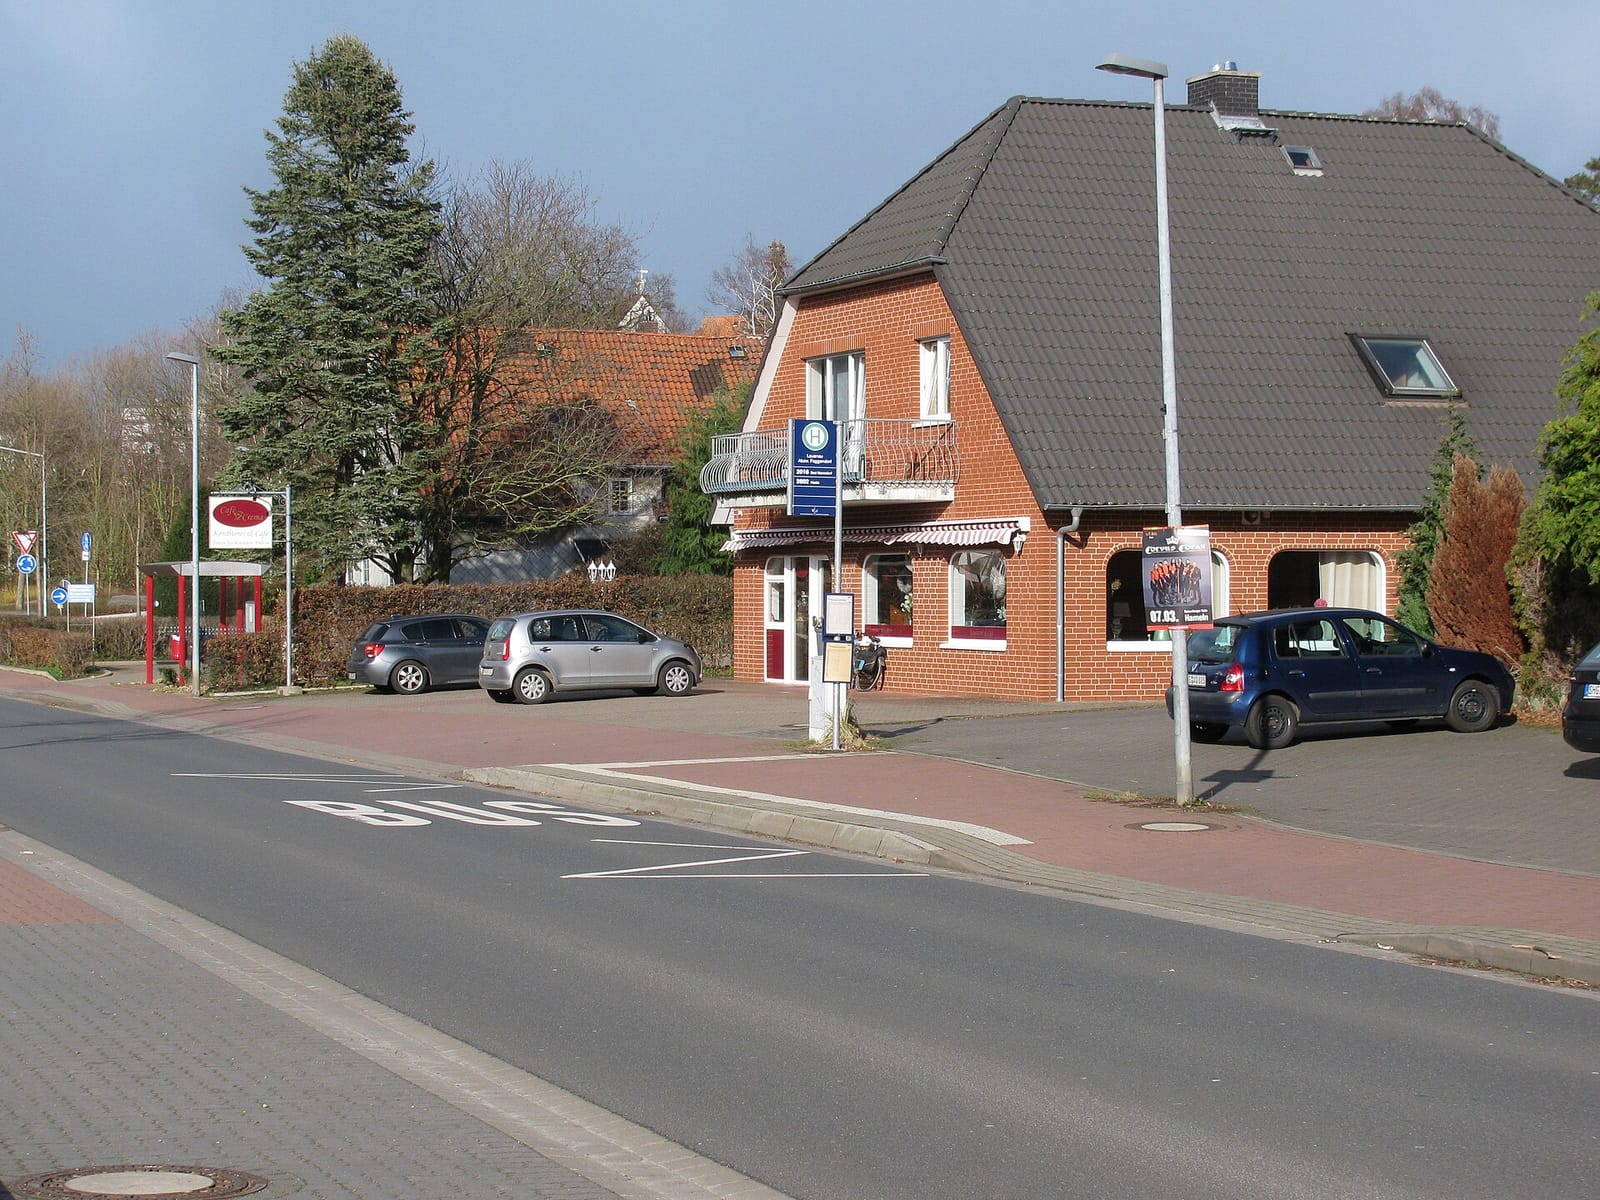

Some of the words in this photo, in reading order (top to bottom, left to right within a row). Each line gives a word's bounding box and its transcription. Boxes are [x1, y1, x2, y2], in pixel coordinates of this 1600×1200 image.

[810, 429, 820, 443] H
[1149, 610, 1179, 623] 07.03.
[283, 800, 641, 827] BUS
